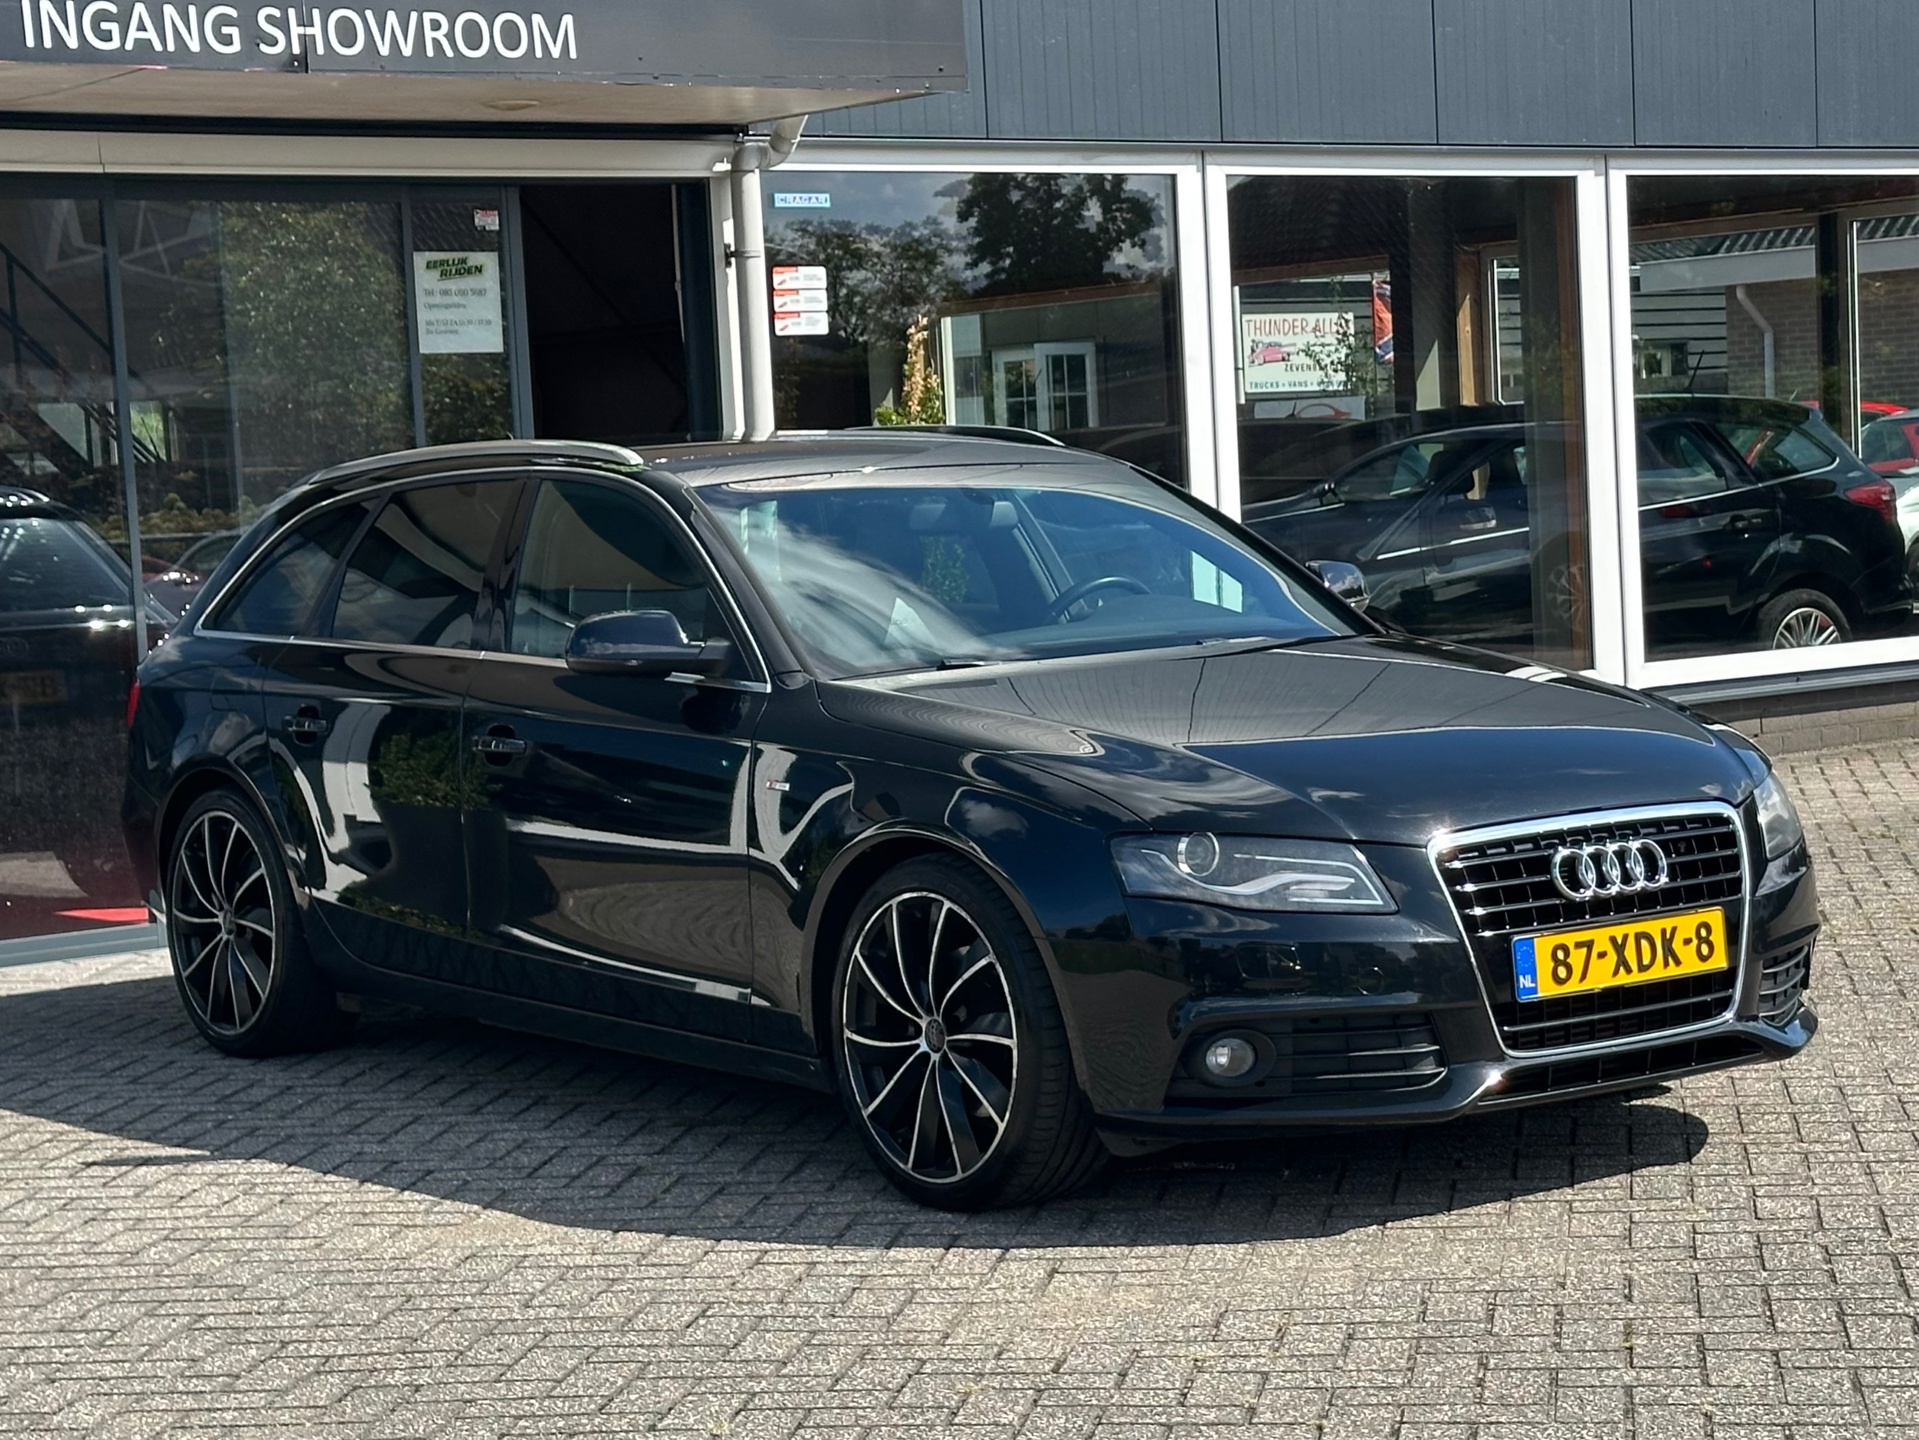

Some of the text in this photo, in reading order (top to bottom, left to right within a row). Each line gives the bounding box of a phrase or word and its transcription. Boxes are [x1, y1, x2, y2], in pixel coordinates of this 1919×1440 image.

[22, 0, 578, 60] INGANG SHOWROOM
[426, 257, 468, 269] EERLIJK
[439, 265, 483, 278] RIJDEN
[1245, 318, 1309, 337] THUNDER
[1249, 381, 1279, 390] TRUCKS
[1287, 380, 1308, 388] VANS
[1551, 920, 1715, 985] 87-XDK-8
[1519, 974, 1536, 989] NL
